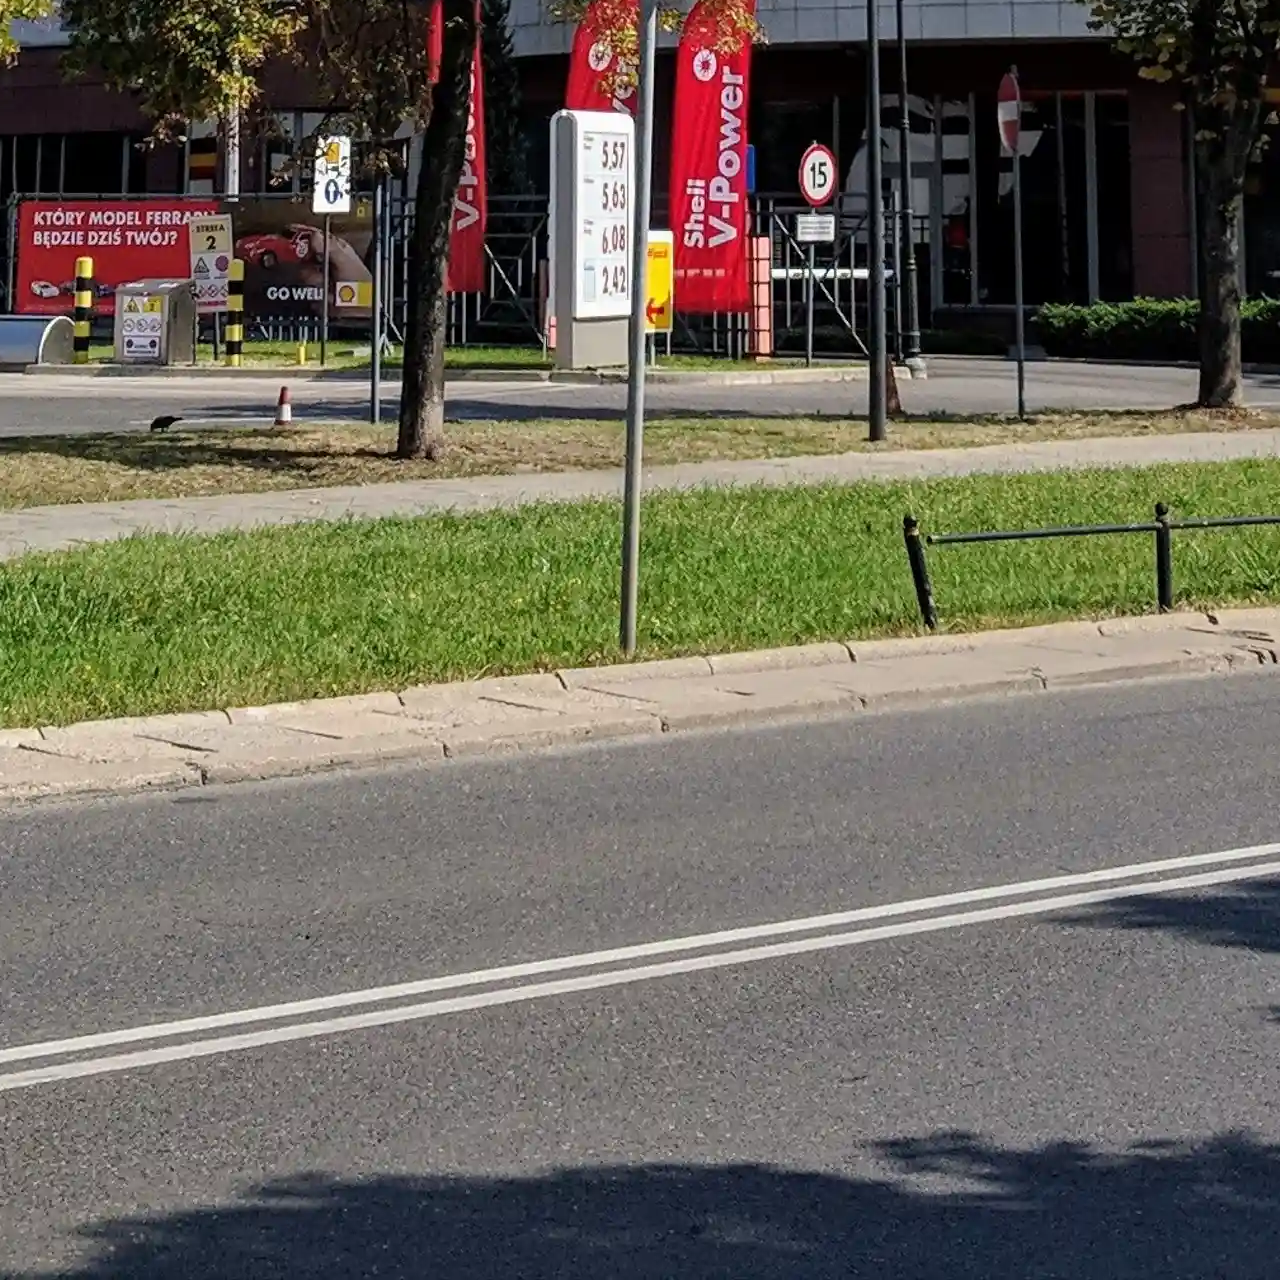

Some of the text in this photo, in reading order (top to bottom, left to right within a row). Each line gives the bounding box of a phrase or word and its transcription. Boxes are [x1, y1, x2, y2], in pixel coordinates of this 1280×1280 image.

[708, 65, 744, 249] V-Power
[810, 162, 827, 190] 15
[34, 208, 86, 226] KTÓRY
[89, 211, 142, 226] MODEL
[684, 179, 705, 249] Shell
[34, 226, 179, 249] BĘDZIE DZIŚ TWÓJ?
[205, 236, 217, 250] 2
[266, 286, 290, 301] GO
